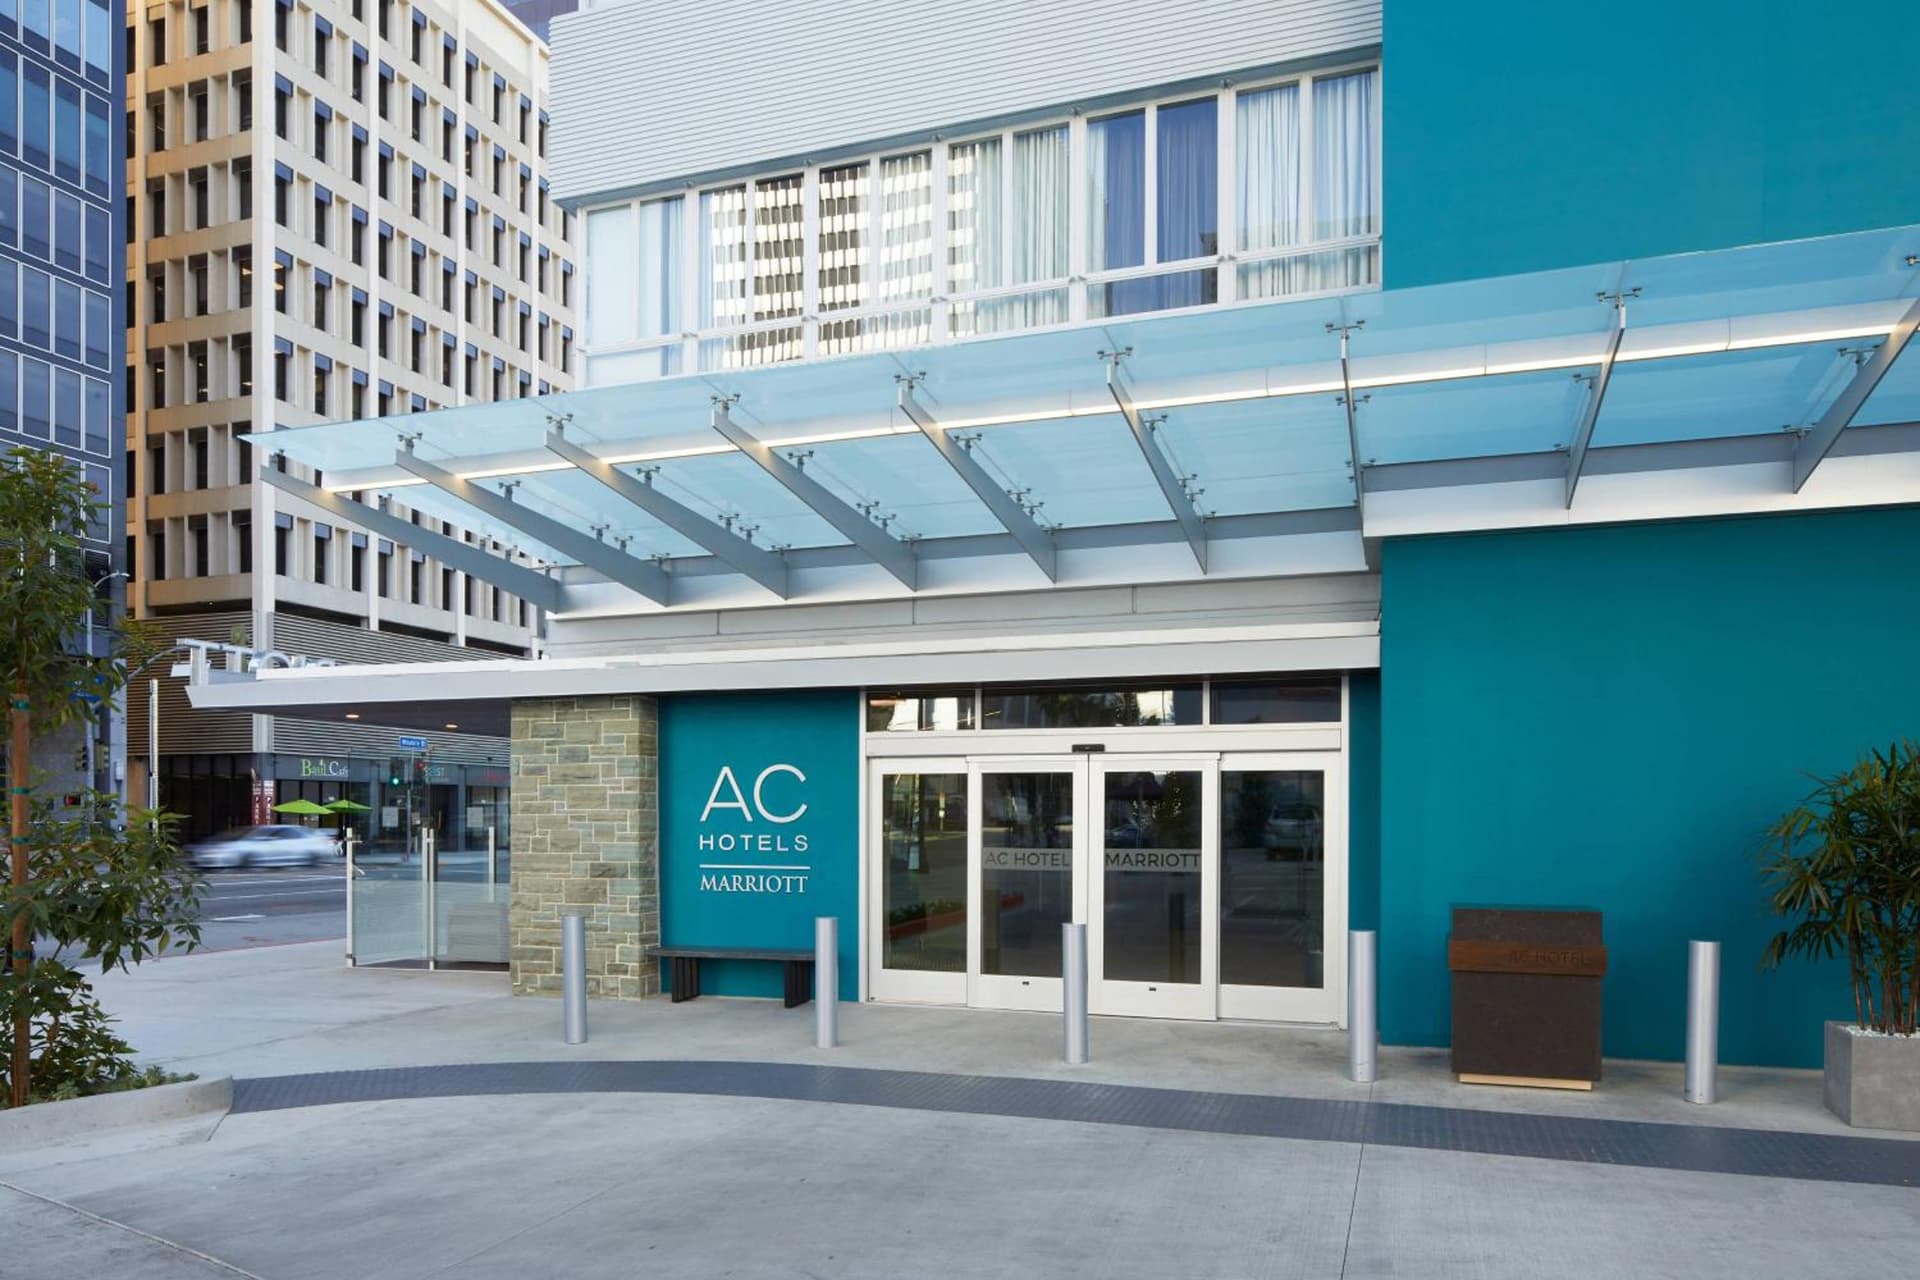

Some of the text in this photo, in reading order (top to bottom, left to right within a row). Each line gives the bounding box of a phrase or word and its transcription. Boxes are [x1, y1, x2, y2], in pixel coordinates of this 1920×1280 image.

[700, 763, 808, 823] AC
[699, 834, 809, 852] HOTELS
[985, 851, 1201, 867] AC HOTEL MARRIOTT
[700, 874, 809, 893] MARRIOTT
